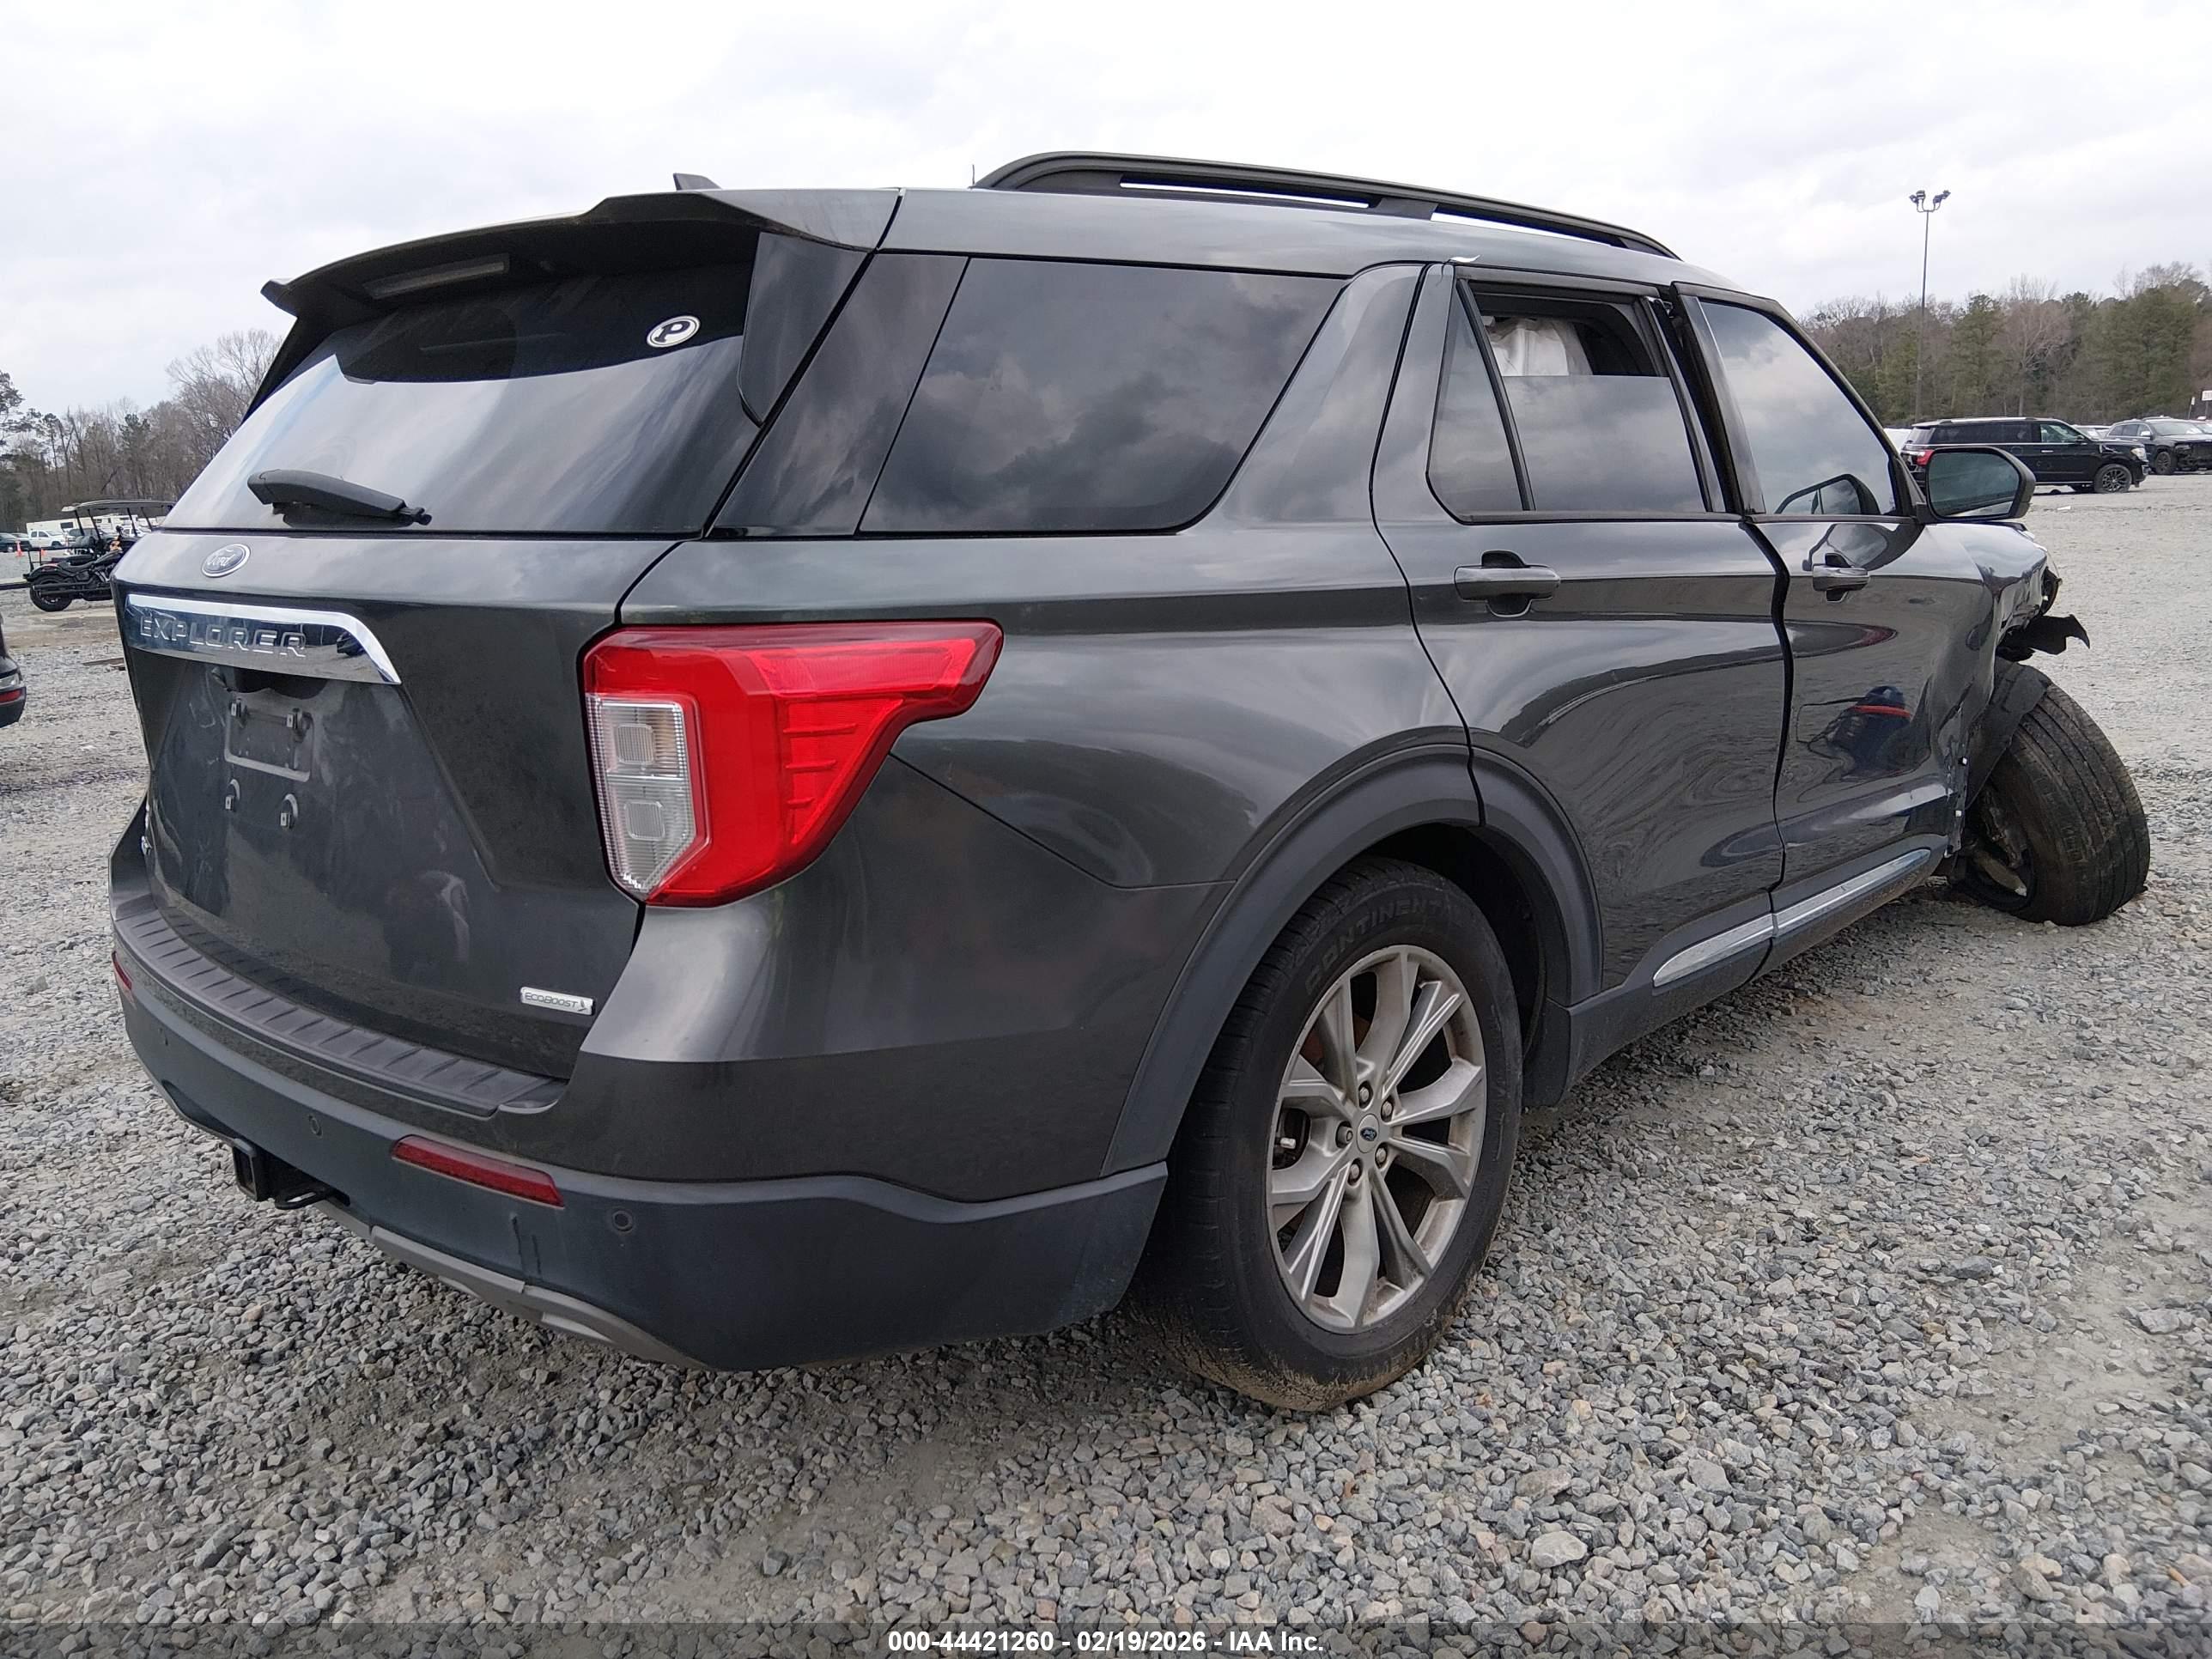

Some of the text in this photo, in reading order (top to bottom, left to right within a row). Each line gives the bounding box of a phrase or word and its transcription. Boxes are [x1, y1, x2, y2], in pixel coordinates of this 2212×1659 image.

[654, 320, 691, 343] P
[140, 615, 307, 658] EXPLORER
[525, 992, 579, 1009] ECOBOOST
